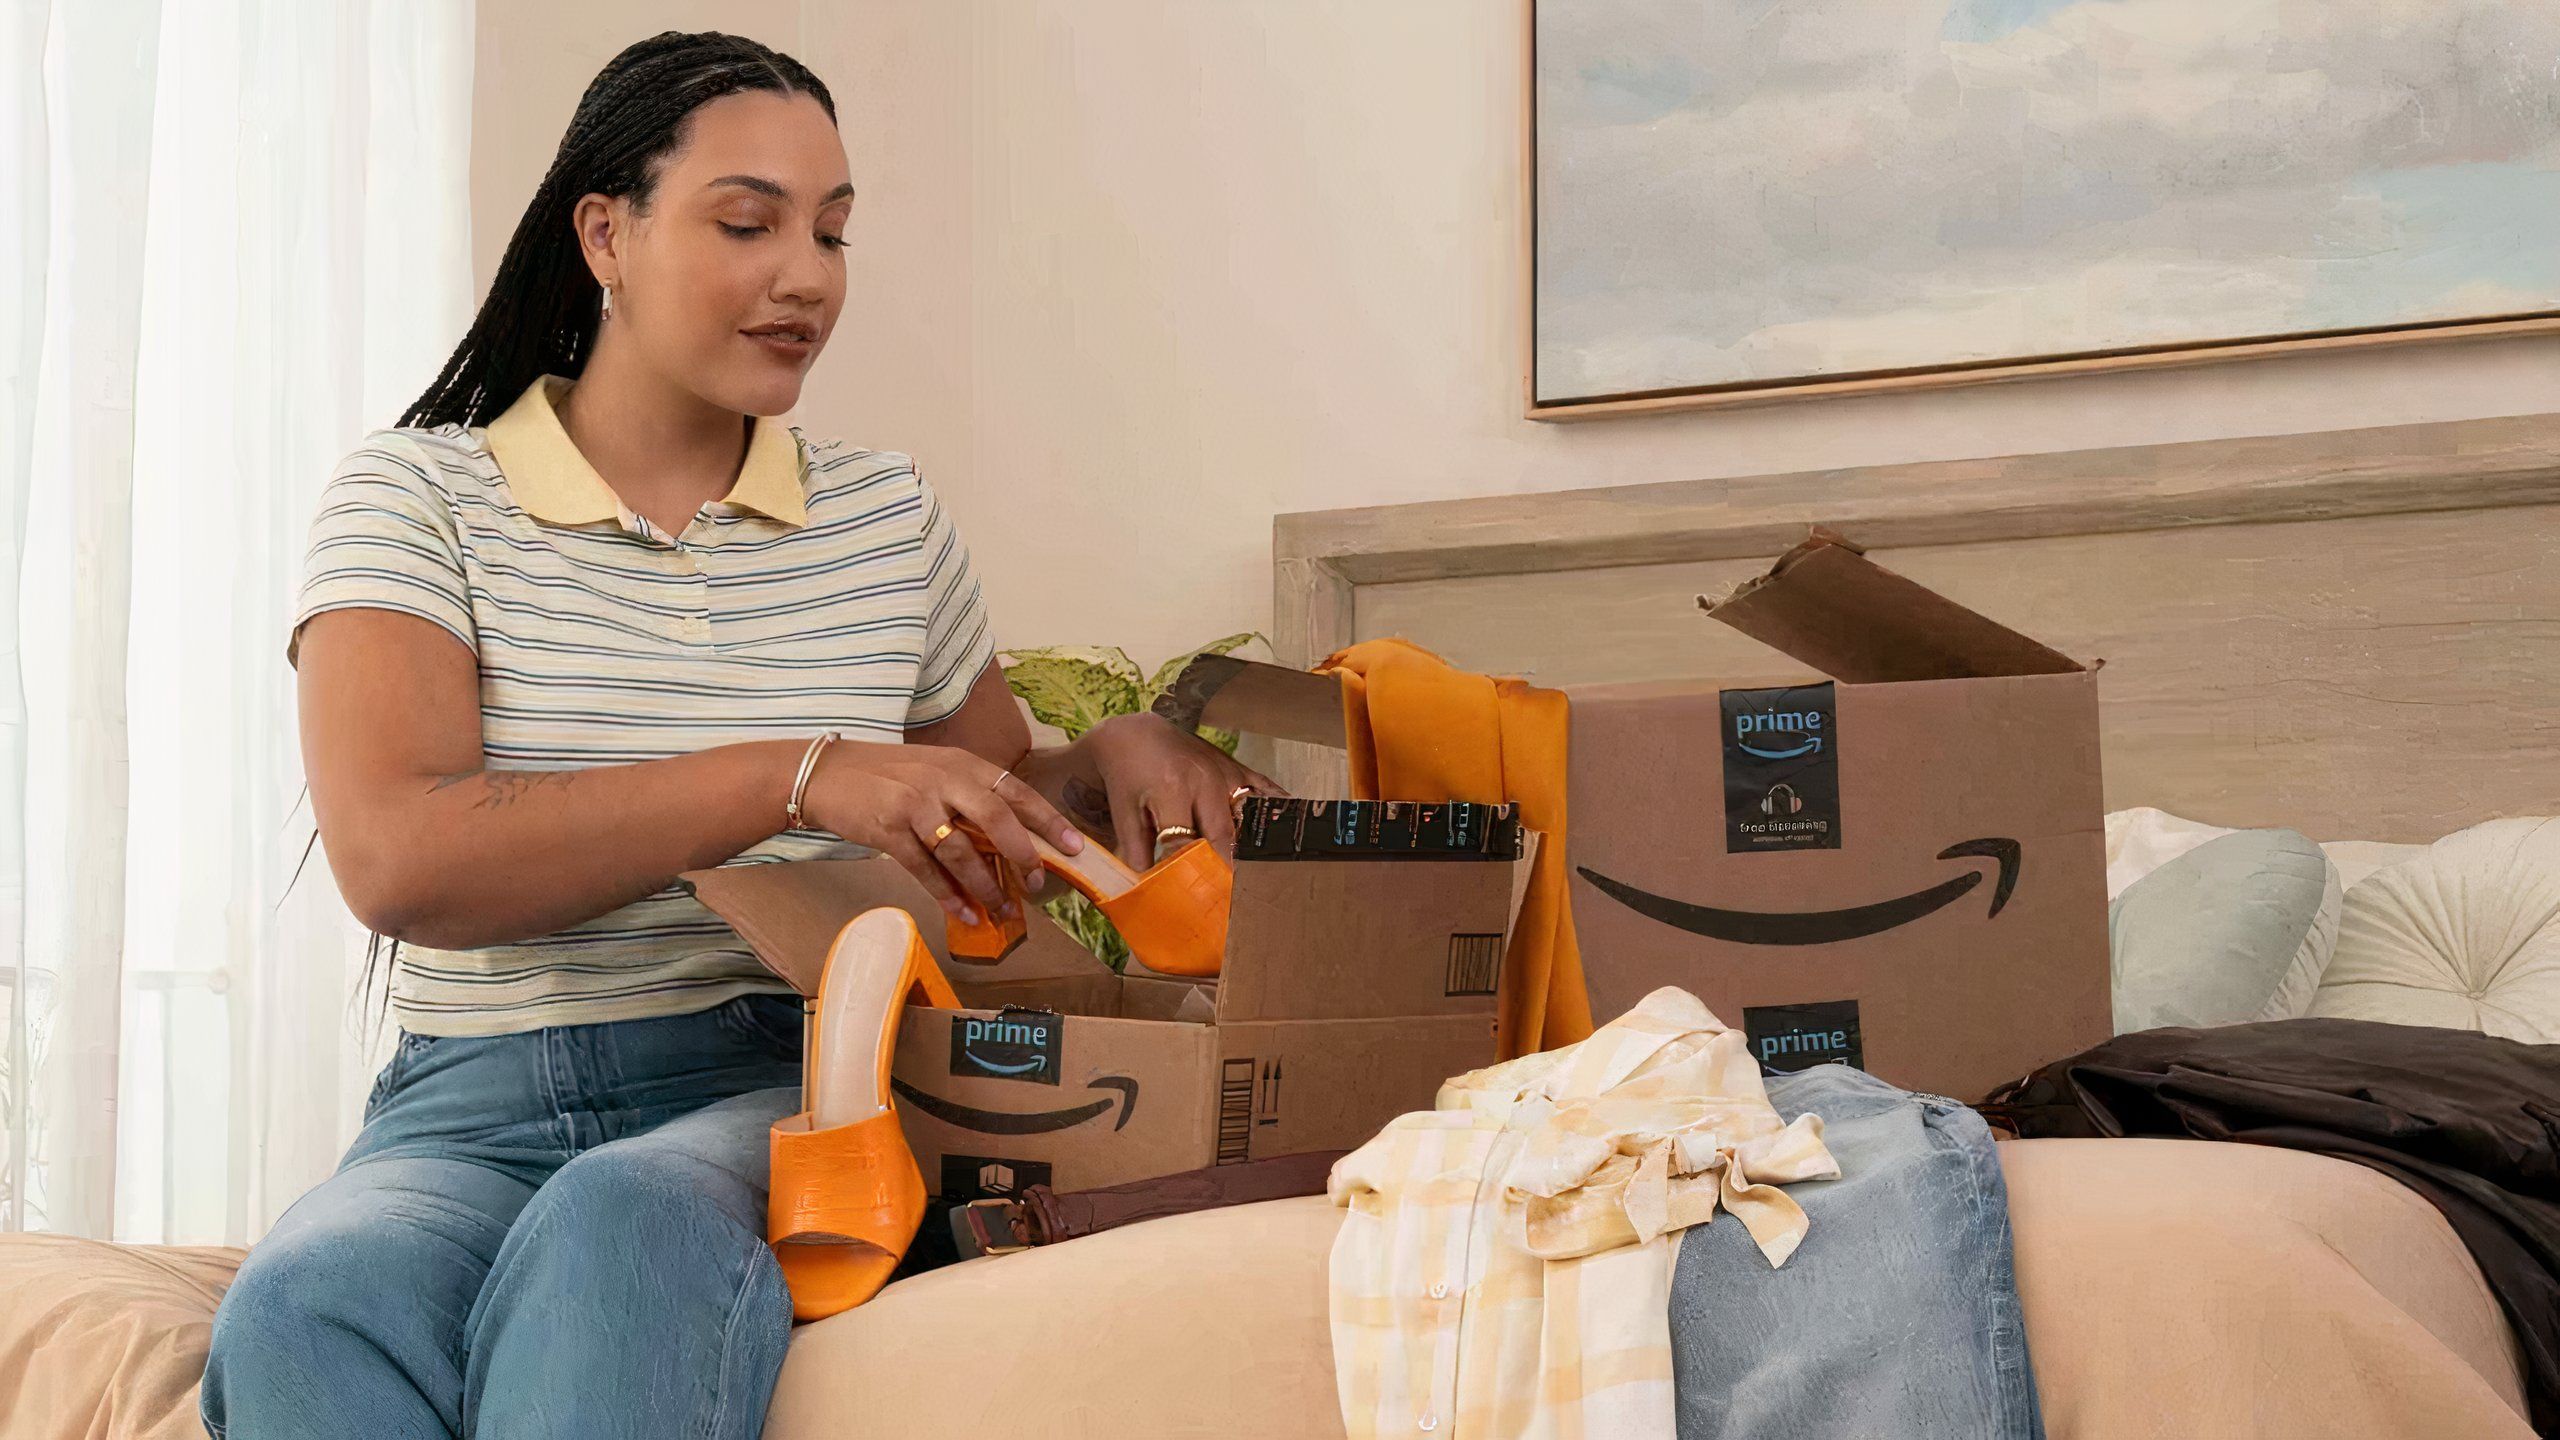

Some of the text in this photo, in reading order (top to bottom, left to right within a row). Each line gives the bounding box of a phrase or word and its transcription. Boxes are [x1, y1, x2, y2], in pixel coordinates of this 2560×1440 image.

[1737, 707, 1821, 739] prime
[965, 1016, 1047, 1047] prime
[1761, 1029, 1847, 1061] prime
